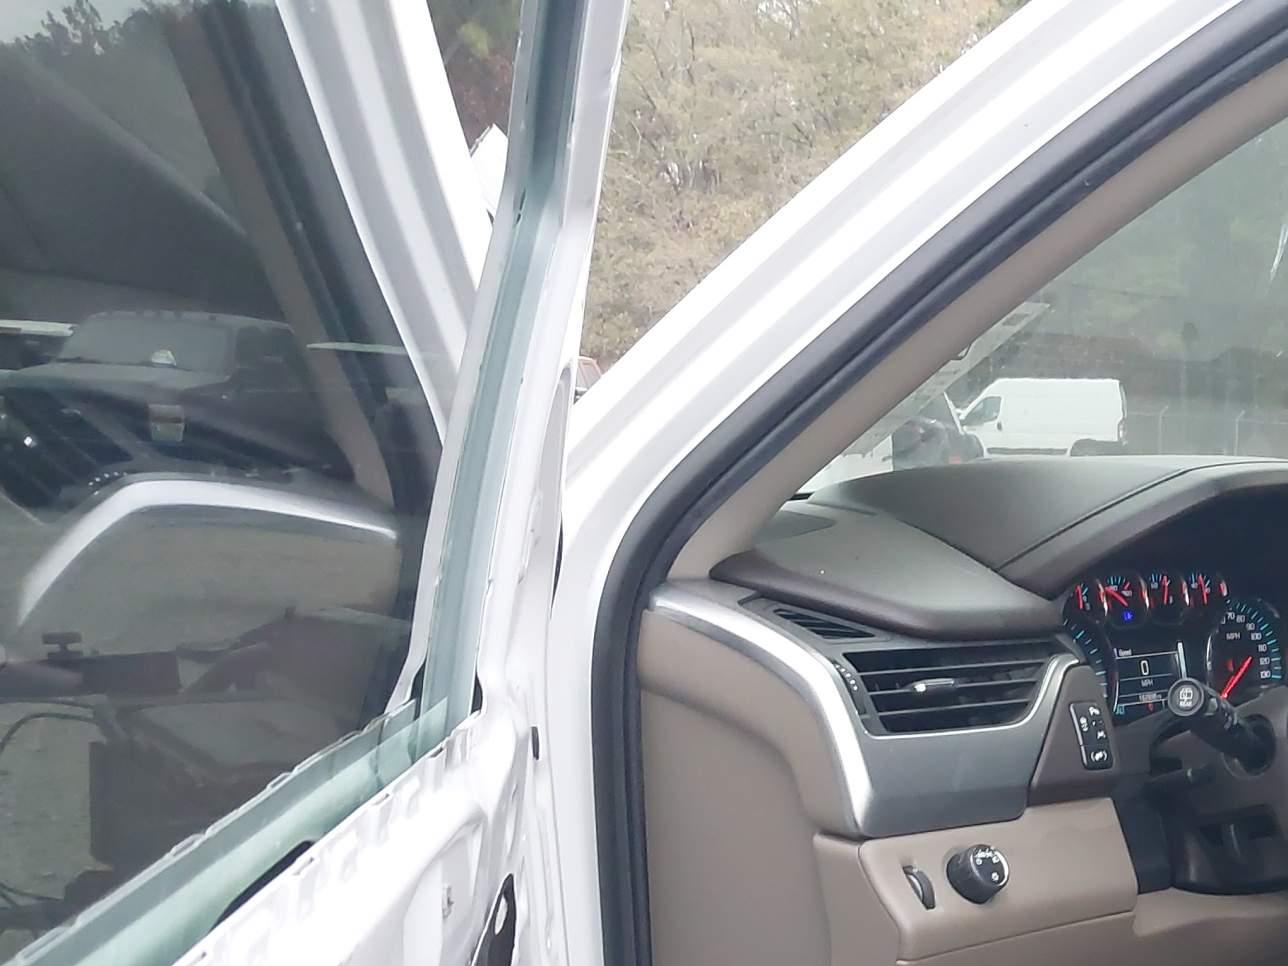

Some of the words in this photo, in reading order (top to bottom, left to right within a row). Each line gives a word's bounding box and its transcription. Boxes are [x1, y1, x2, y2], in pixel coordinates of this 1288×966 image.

[1227, 612, 1235, 620] 70
[1246, 623, 1256, 631] 90
[1250, 633, 1262, 641] 100
[1258, 644, 1267, 652] 110
[1259, 657, 1270, 665] 120
[1140, 659, 1150, 676] 0
[1260, 671, 1271, 679] 130
